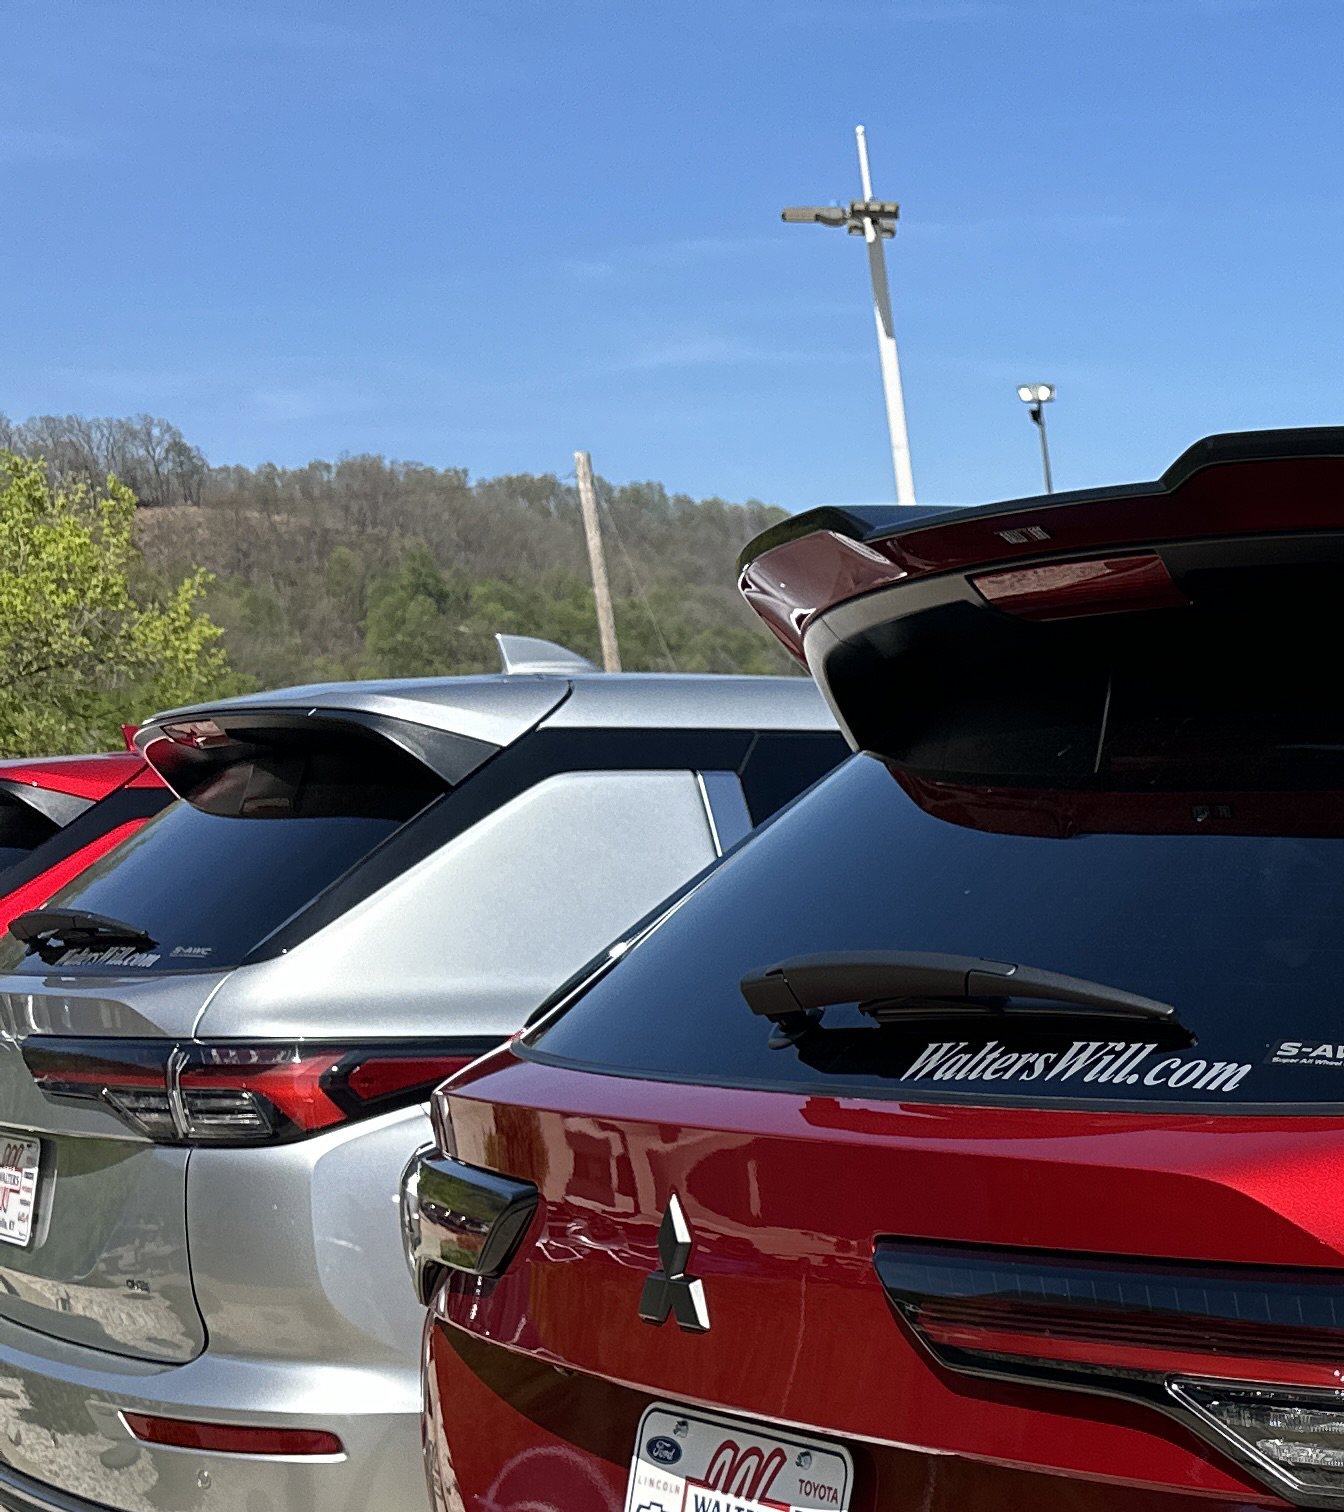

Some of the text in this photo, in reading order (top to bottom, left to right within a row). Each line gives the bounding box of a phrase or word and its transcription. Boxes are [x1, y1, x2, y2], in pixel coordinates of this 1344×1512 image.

[900, 1041, 1252, 1093] WaltersWill.com
[1272, 1056, 1299, 1064] Super
[1315, 1059, 1342, 1067] Wheel
[637, 1475, 680, 1495] LINCOLN
[798, 1478, 839, 1504] TOYOTA
